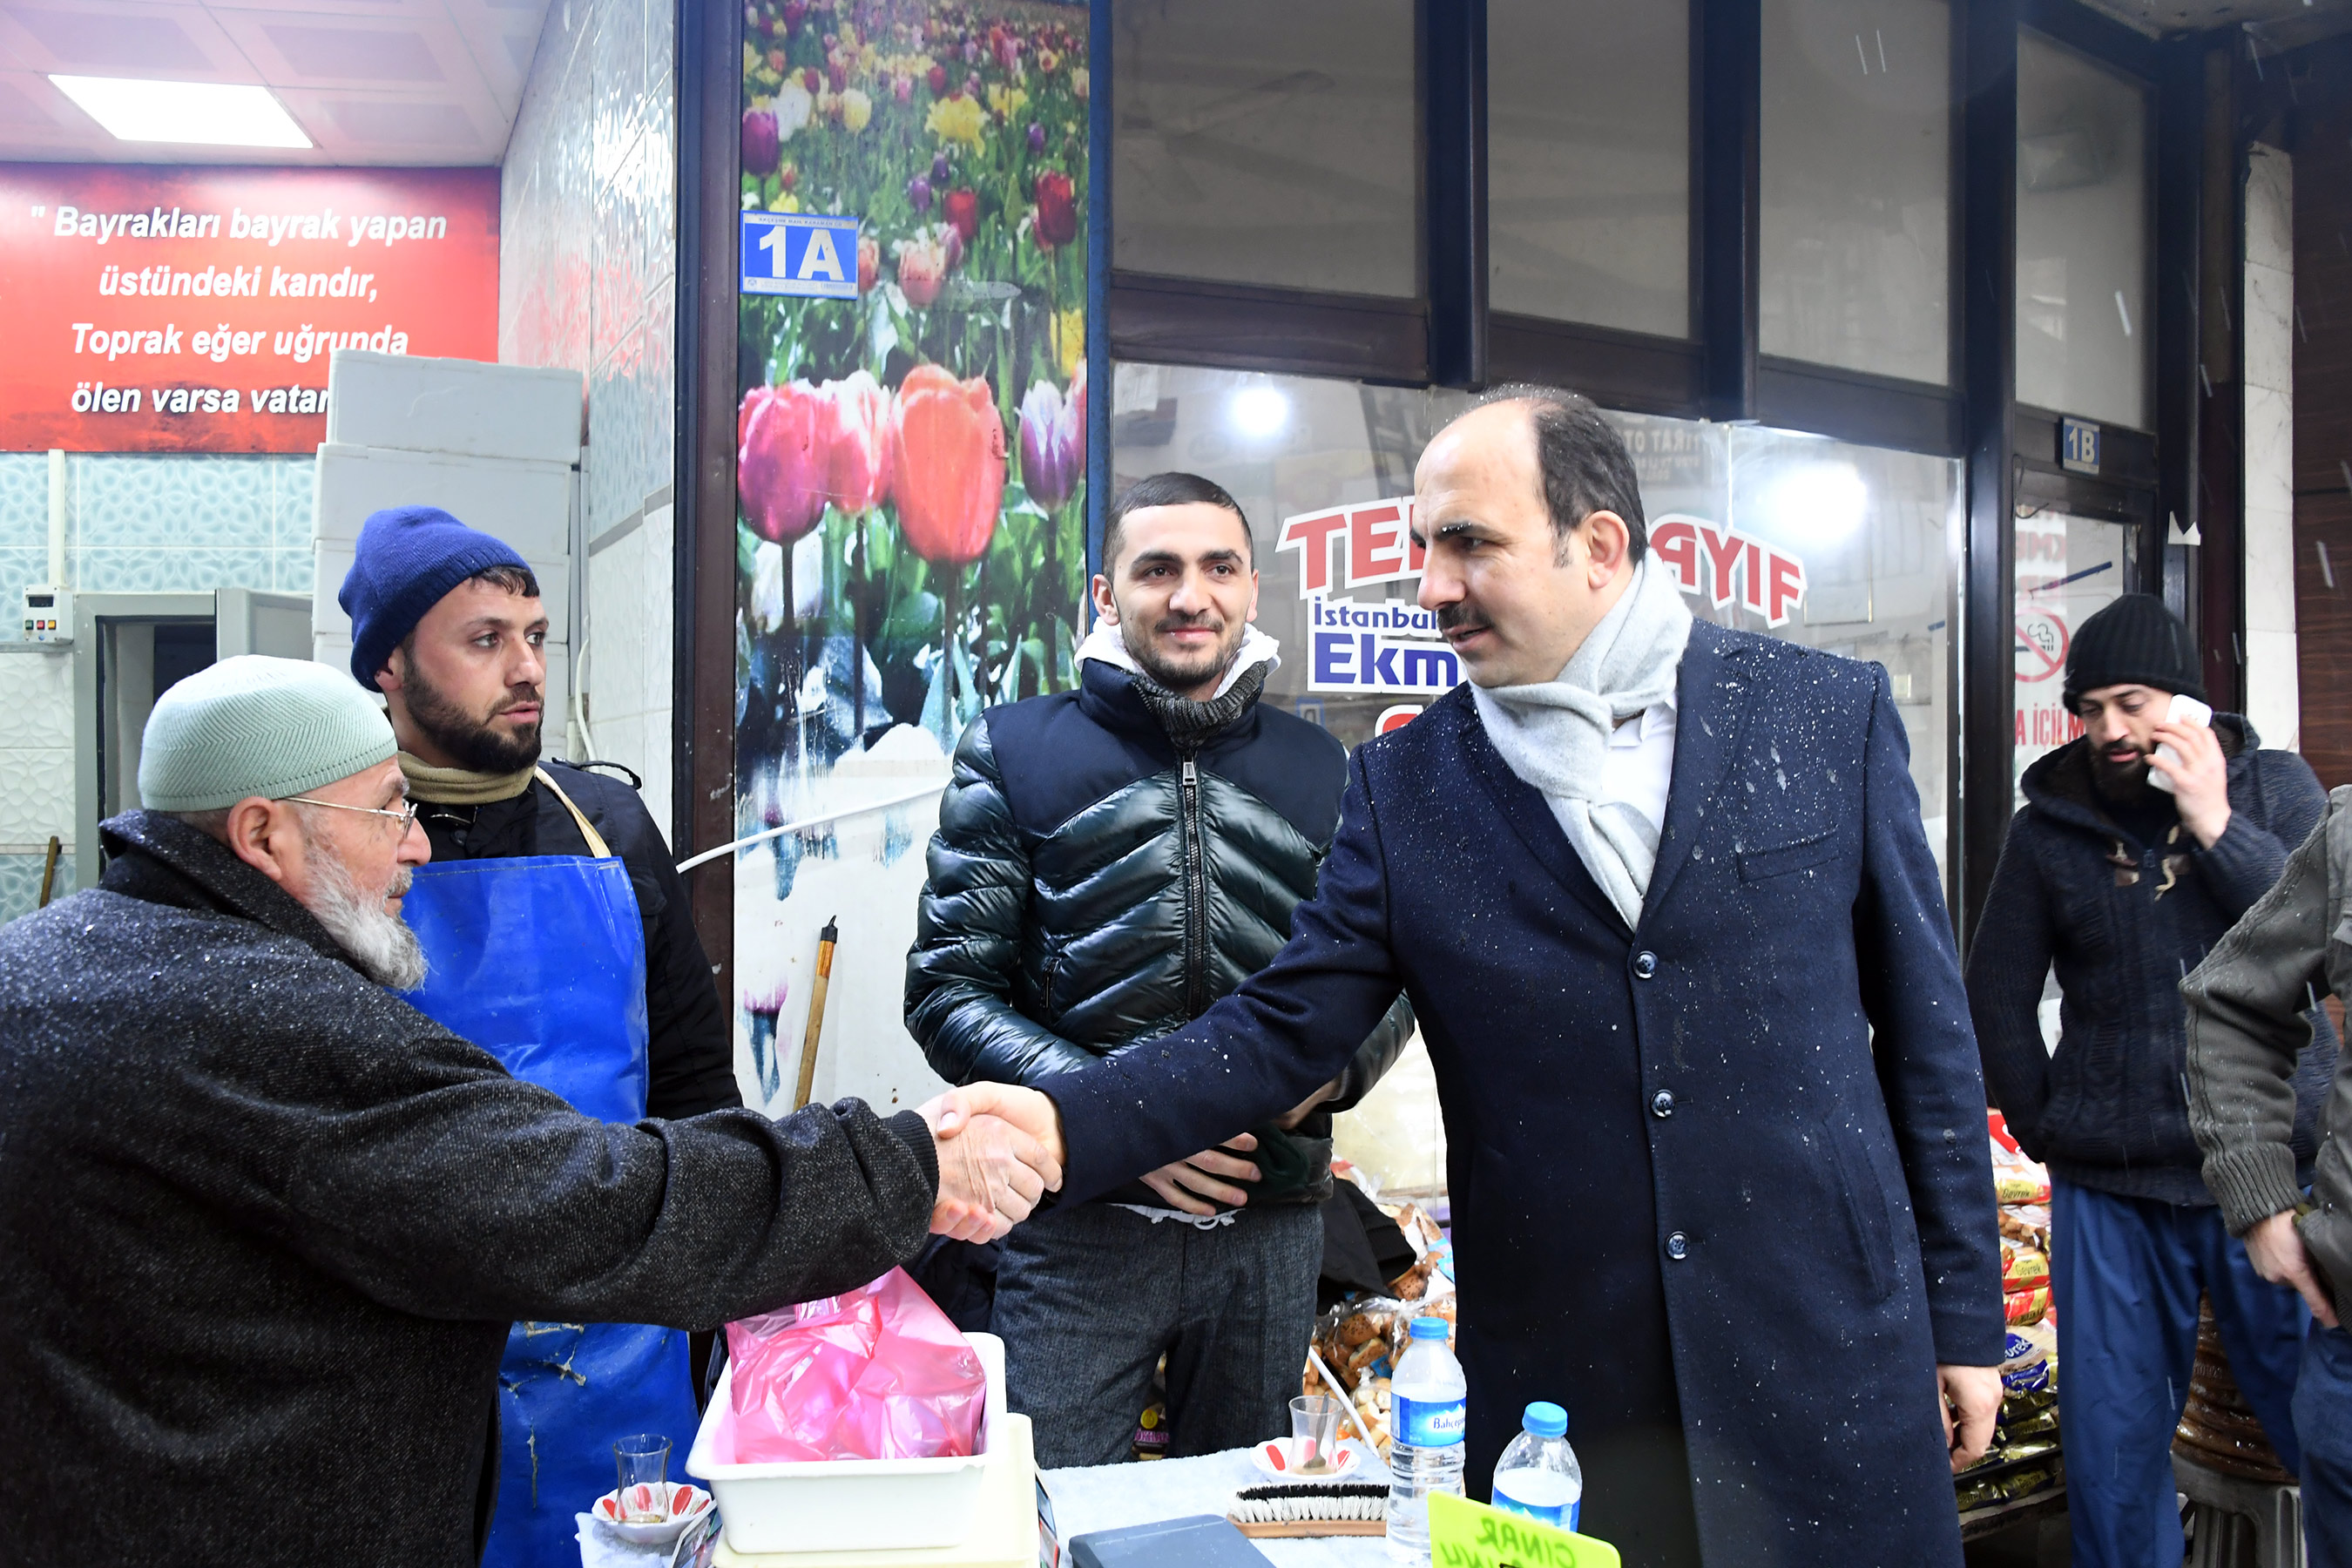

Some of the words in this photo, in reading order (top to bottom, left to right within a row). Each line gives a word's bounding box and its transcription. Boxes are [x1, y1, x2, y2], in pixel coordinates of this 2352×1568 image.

[54, 206, 220, 245] Bayrakları
[229, 207, 340, 246] bayrak
[348, 213, 447, 246] yapan
[759, 224, 845, 281] 1A
[98, 266, 261, 298] üstündeki
[269, 267, 378, 303] kandır,
[71, 323, 183, 361] Toprak
[192, 323, 267, 362] eğer
[274, 323, 409, 363] uğrunda
[71, 382, 141, 414] ölen
[152, 389, 240, 414] varsa
[2069, 426, 2095, 463] 1B
[1650, 522, 1801, 621] AYIF
[1315, 632, 1458, 687] Ekm
[2032, 702, 2085, 751] İÇİLM
